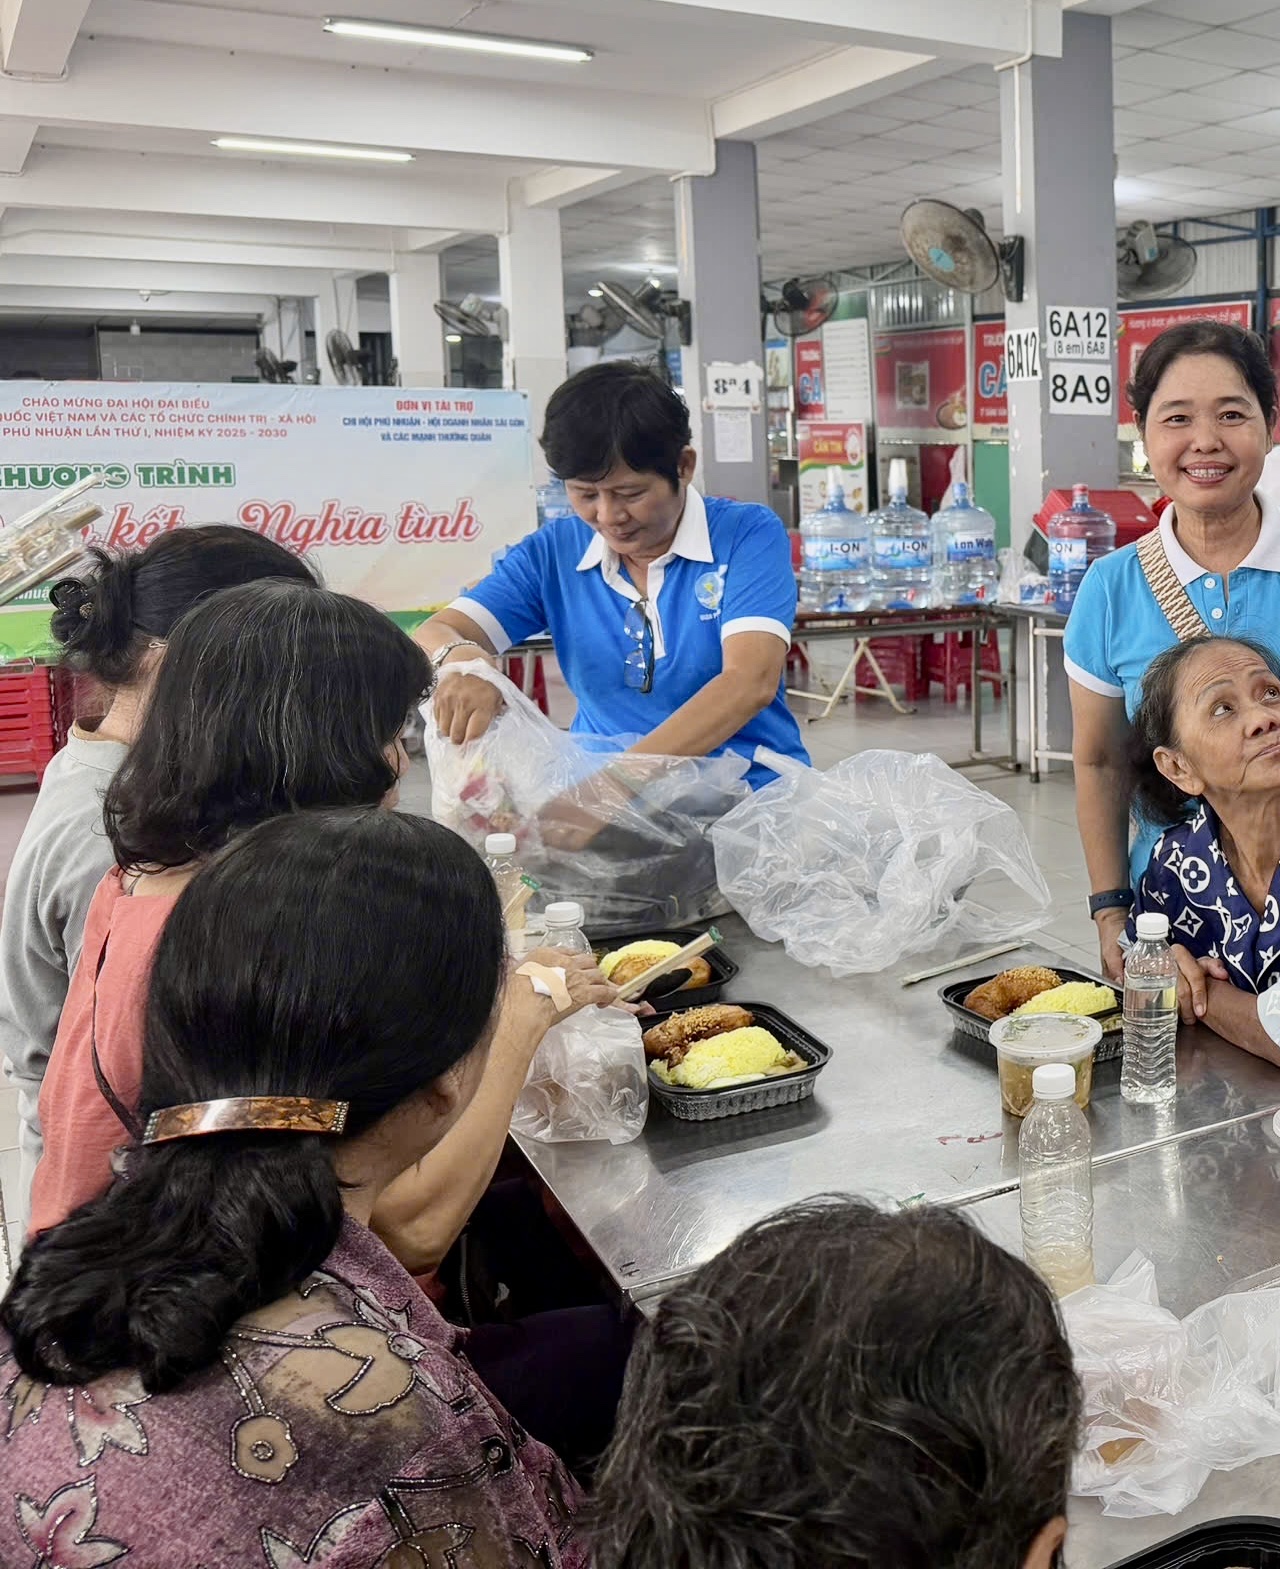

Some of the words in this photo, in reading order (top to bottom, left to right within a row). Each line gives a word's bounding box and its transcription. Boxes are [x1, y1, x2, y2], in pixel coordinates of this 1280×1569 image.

[1049, 310, 1108, 338] 6A12
[1007, 331, 1038, 379] 6A12
[1066, 340, 1084, 357] em)
[1052, 374, 1110, 404] 8A9
[22, 396, 60, 408] CHÀO
[63, 397, 103, 408] MỪNG
[107, 399, 129, 410] ĐẠI
[132, 398, 154, 410] HỘI
[396, 400, 419, 412] ĐƠN
[422, 400, 431, 414] VỊ
[435, 400, 451, 411] TÀI
[455, 401, 474, 413] TRỢ
[35, 411, 64, 424] VIỆT
[67, 412, 97, 423] NAM
[100, 412, 117, 423] VÀ
[121, 411, 146, 423] CÁC
[169, 411, 204, 423] CHỨC
[207, 411, 246, 423] CHÍNH
[249, 414, 267, 426] TRỊ
[296, 412, 317, 425] HỘI
[35, 426, 82, 439] NHUẬN
[155, 427, 195, 438] NHIỆM
[217, 428, 247, 438] 2025
[258, 428, 288, 438] 2030
[0, 464, 129, 488] HƯƠNG
[137, 460, 235, 487] TRÌNH
[239, 500, 390, 554] Nghĩa
[395, 496, 483, 543] tình
[829, 542, 860, 553] I-ON
[902, 540, 928, 551] I-ON
